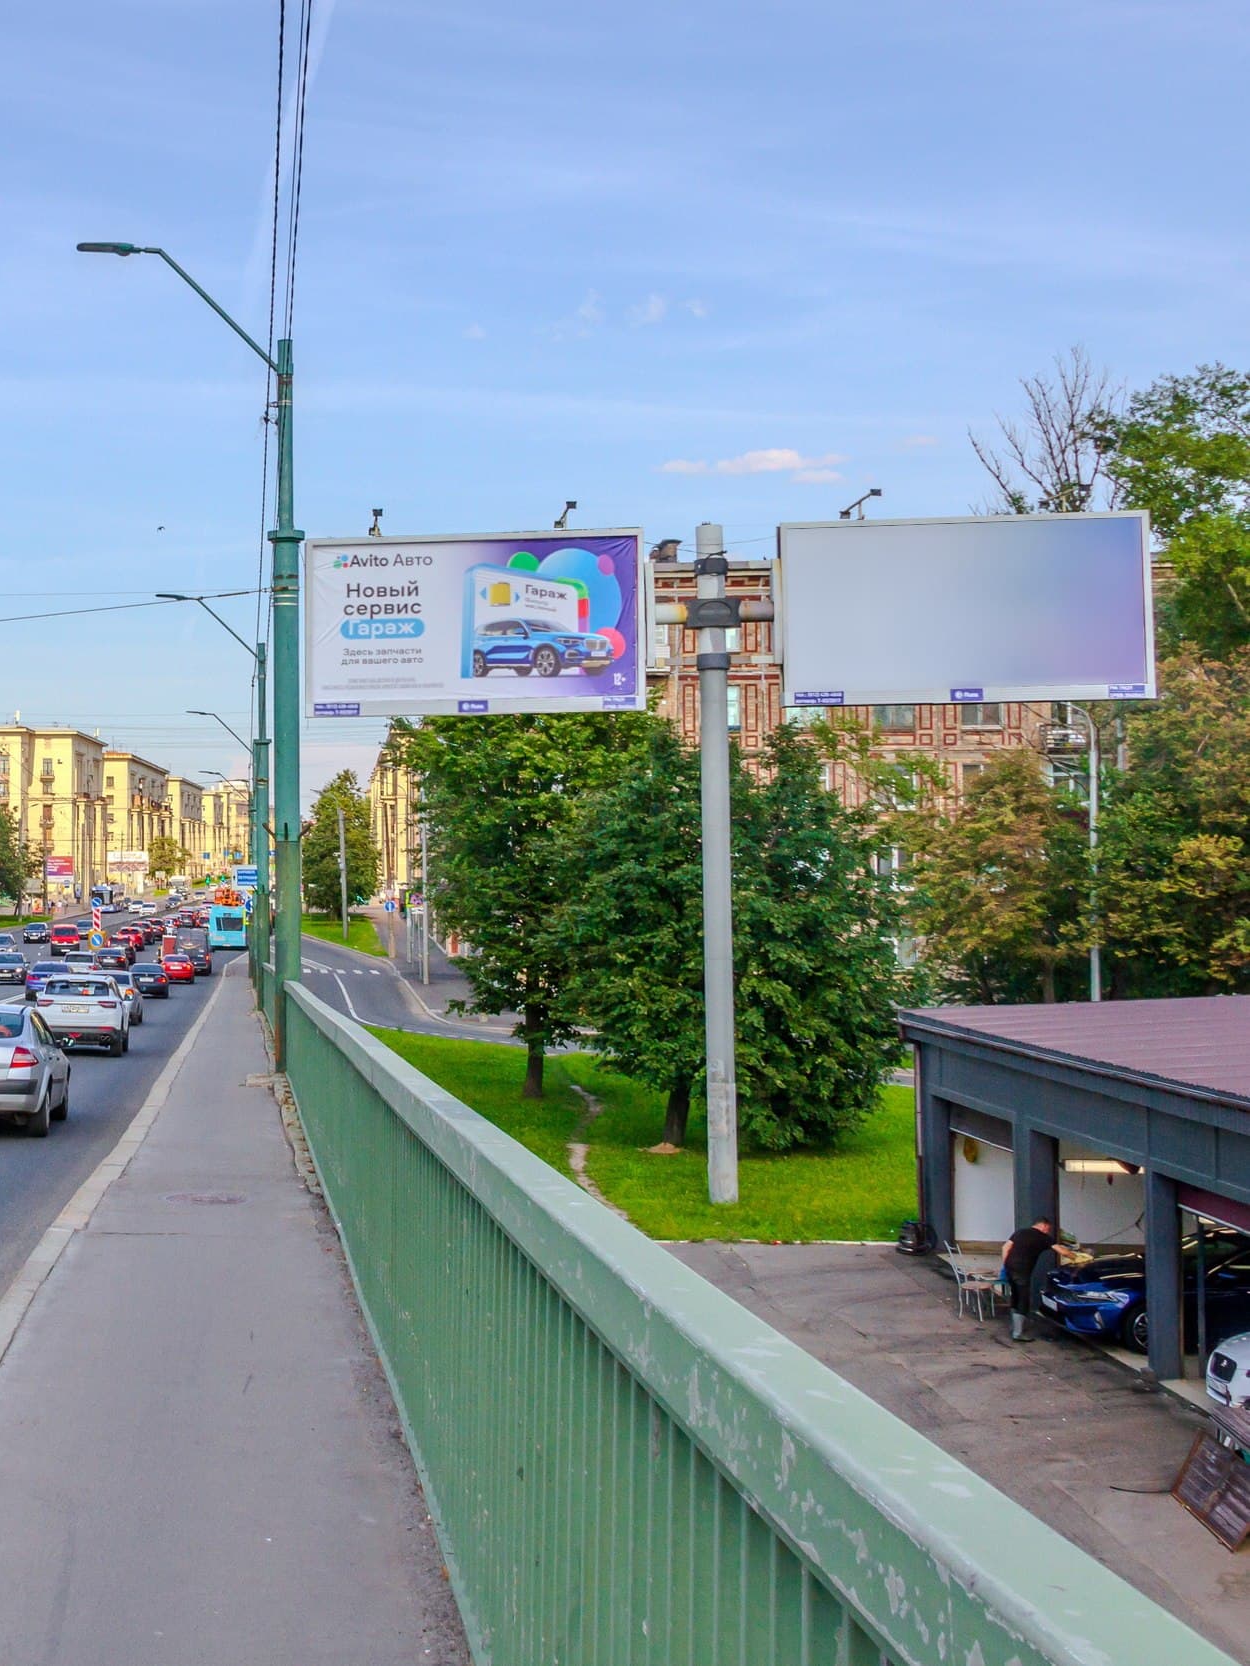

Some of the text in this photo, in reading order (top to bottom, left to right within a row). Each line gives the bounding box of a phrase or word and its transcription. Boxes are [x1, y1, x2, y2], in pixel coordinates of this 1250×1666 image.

[350, 553, 433, 568] Avito Авто
[346, 580, 419, 598] Новый
[525, 584, 568, 600] Гараж
[343, 602, 422, 619] сервис
[349, 620, 415, 639] Гараж
[343, 647, 422, 657] Здесь запчасти
[341, 656, 424, 666] для вашего авто
